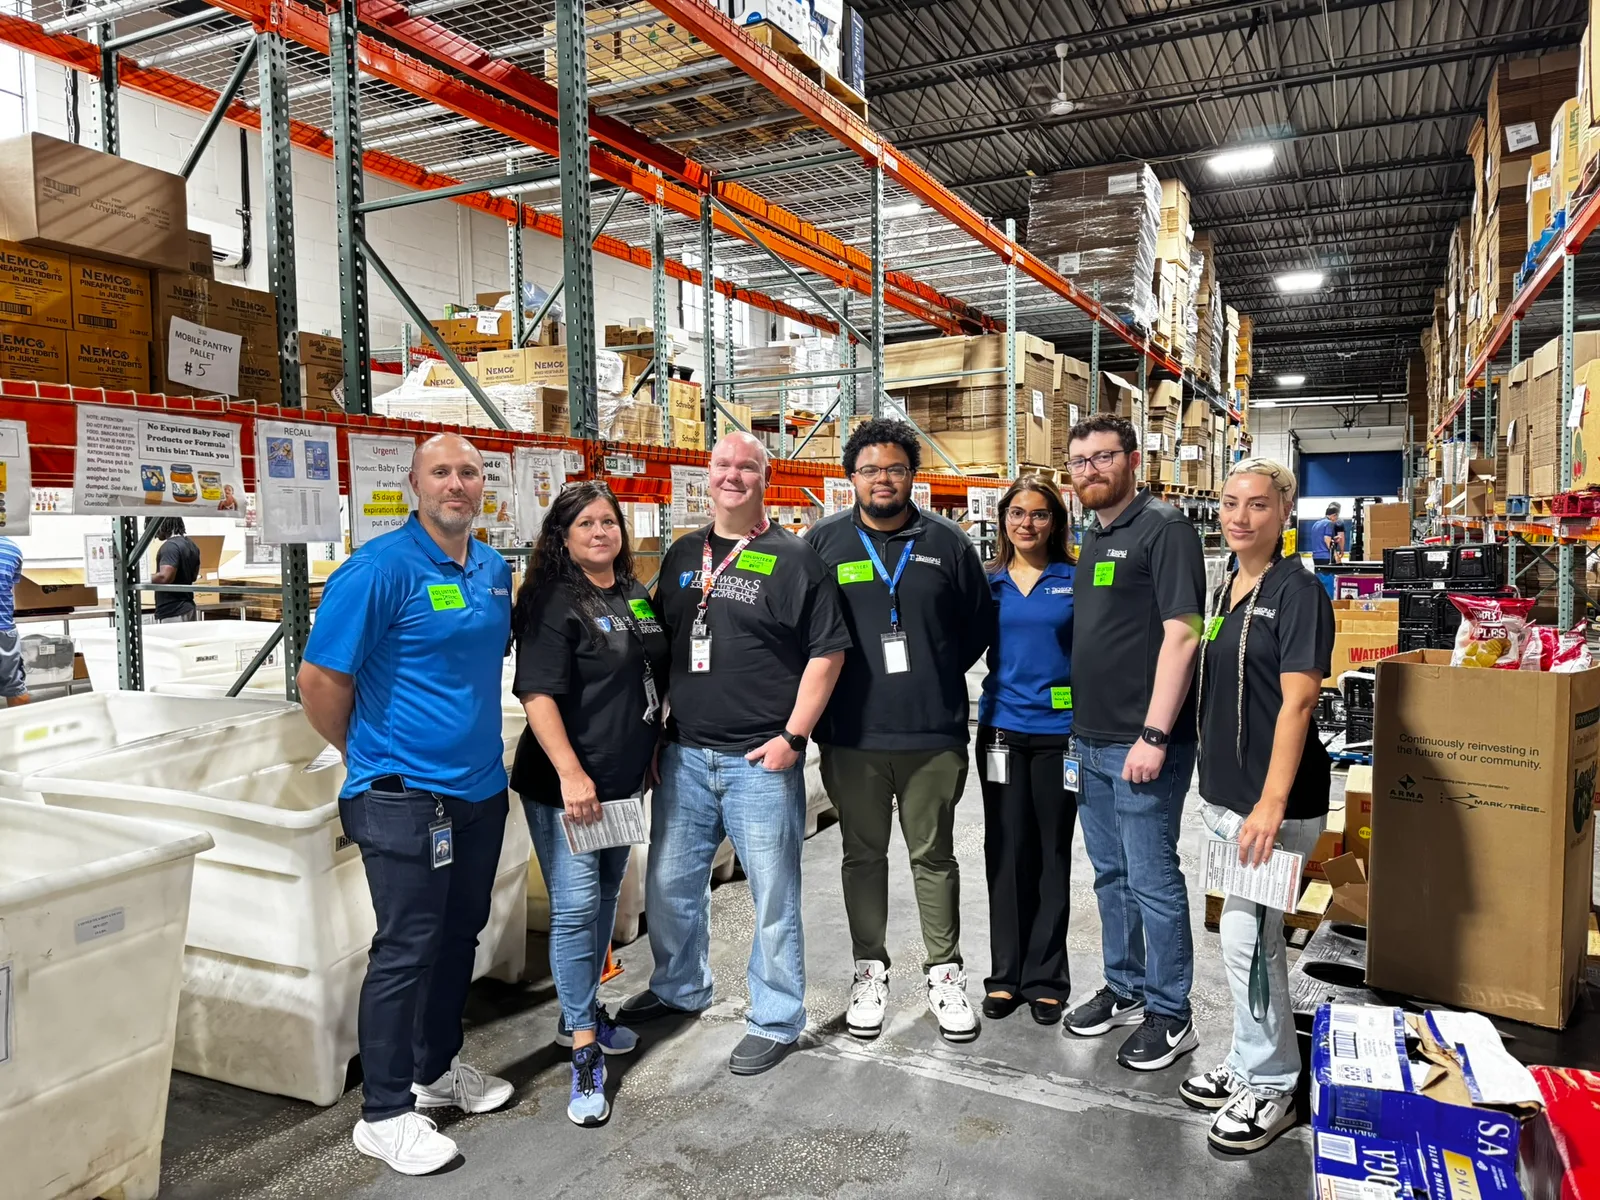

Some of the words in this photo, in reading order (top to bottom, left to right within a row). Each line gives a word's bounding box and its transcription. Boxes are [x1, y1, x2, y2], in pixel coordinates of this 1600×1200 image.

[88, 202, 137, 220] HOSPITALITY
[0, 264, 33, 276] NEAPPLE
[35, 270, 63, 282] TIDBITS
[21, 276, 43, 286] JUICE
[80, 279, 118, 292] PINEAPPLE
[119, 285, 144, 297] TIDBITS
[106, 291, 127, 300] JUICE
[0, 334, 46, 349] EMCO
[174, 330, 201, 346] MOBILE
[202, 340, 233, 354] PANTRY
[17, 354, 40, 364] JUICE
[31, 348, 59, 359] TIDBITS
[189, 347, 216, 361] PALLET
[78, 355, 116, 366] PINEAPPLE
[117, 359, 143, 369] TIDBITS
[105, 366, 124, 375] JUICE
[184, 361, 193, 376] #
[196, 363, 212, 377] 5
[551, 404, 568, 415] NEM
[147, 422, 159, 430] No
[160, 424, 191, 434] Expired
[192, 428, 211, 437] Baby
[212, 430, 230, 439] Food
[283, 427, 313, 437] RECALL
[147, 434, 183, 444] Products
[194, 438, 226, 448] Formula
[156, 445, 172, 454] this
[173, 447, 189, 455] bin!
[190, 449, 215, 458] Thank
[372, 446, 399, 456] Urgent!
[356, 464, 377, 472] Product:
[378, 464, 395, 473] Baby
[86, 474, 109, 482] weighed
[487, 473, 501, 482] Bin
[376, 480, 382, 488] If
[382, 480, 402, 488] within
[381, 493, 395, 503] days
[396, 493, 403, 501] of
[363, 506, 394, 515] expiration
[371, 520, 383, 528] put
[383, 518, 390, 526] in
[743, 554, 773, 563] VOLUNTEER
[717, 590, 735, 600] GIVES
[735, 594, 756, 605] BACK
[1350, 644, 1399, 662] WATERM
[1399, 733, 1465, 751] Continuously
[1467, 741, 1527, 757] reinvesting
[1529, 746, 1540, 756] in
[1397, 745, 1413, 755] the
[1415, 746, 1445, 759] future
[1447, 750, 1457, 760] of
[1459, 754, 1478, 763] our
[1480, 755, 1542, 770] community.
[1389, 789, 1424, 800] ARMA
[1427, 1144, 1441, 1169] WATER
